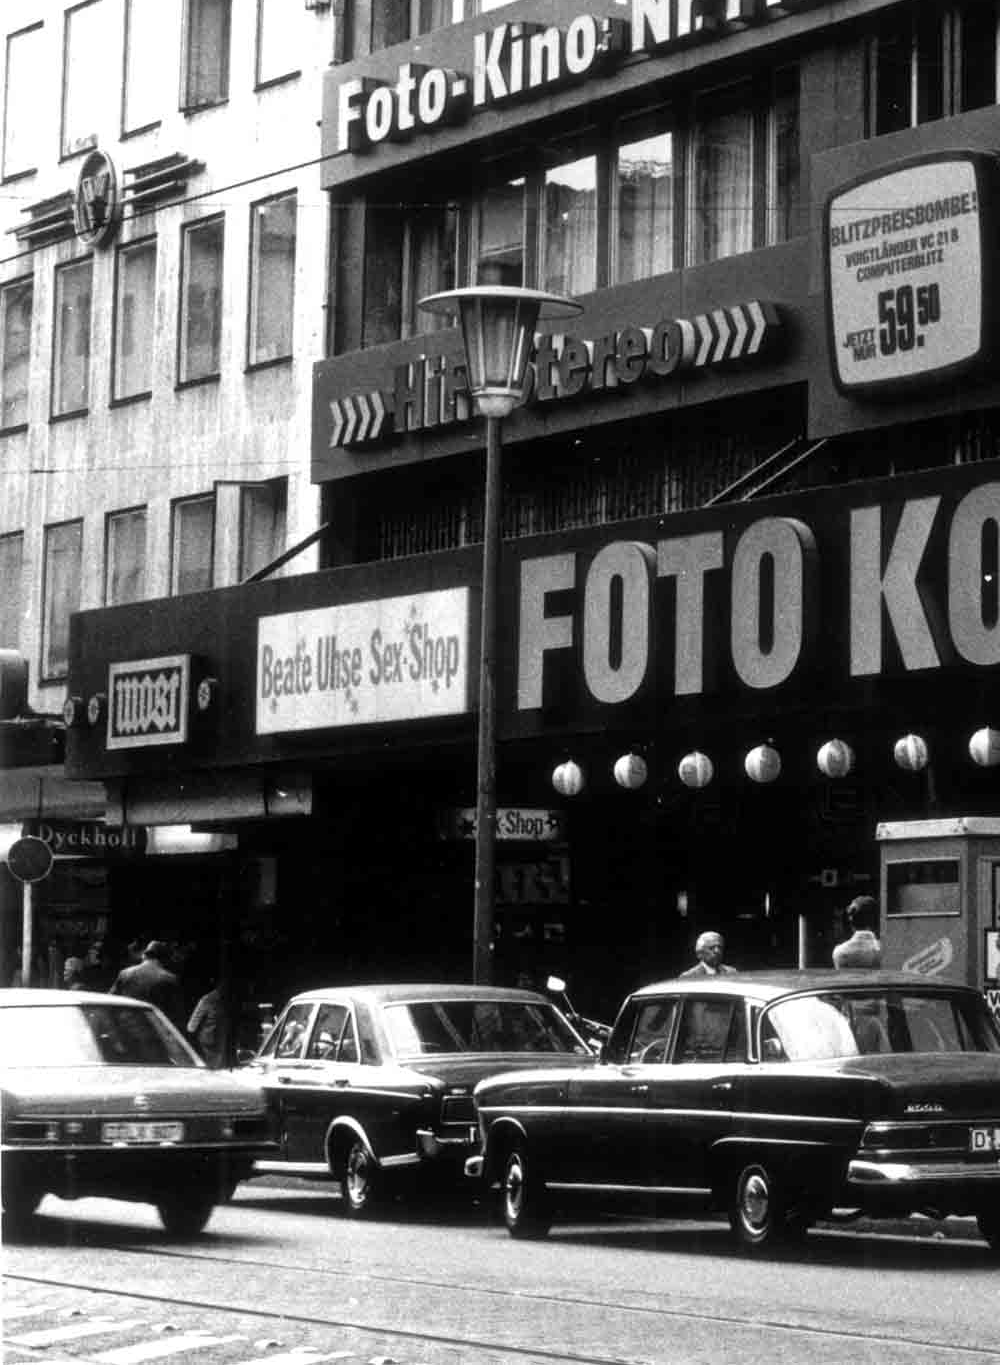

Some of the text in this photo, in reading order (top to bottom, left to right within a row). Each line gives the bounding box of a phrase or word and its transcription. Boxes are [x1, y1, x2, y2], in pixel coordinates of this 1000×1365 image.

[856, 249, 944, 283] COMPUTERBLITZ
[842, 328, 876, 349] JETZT
[517, 516, 804, 711] FOTO
[260, 641, 313, 700] Beate
[317, 635, 362, 691] Uhse
